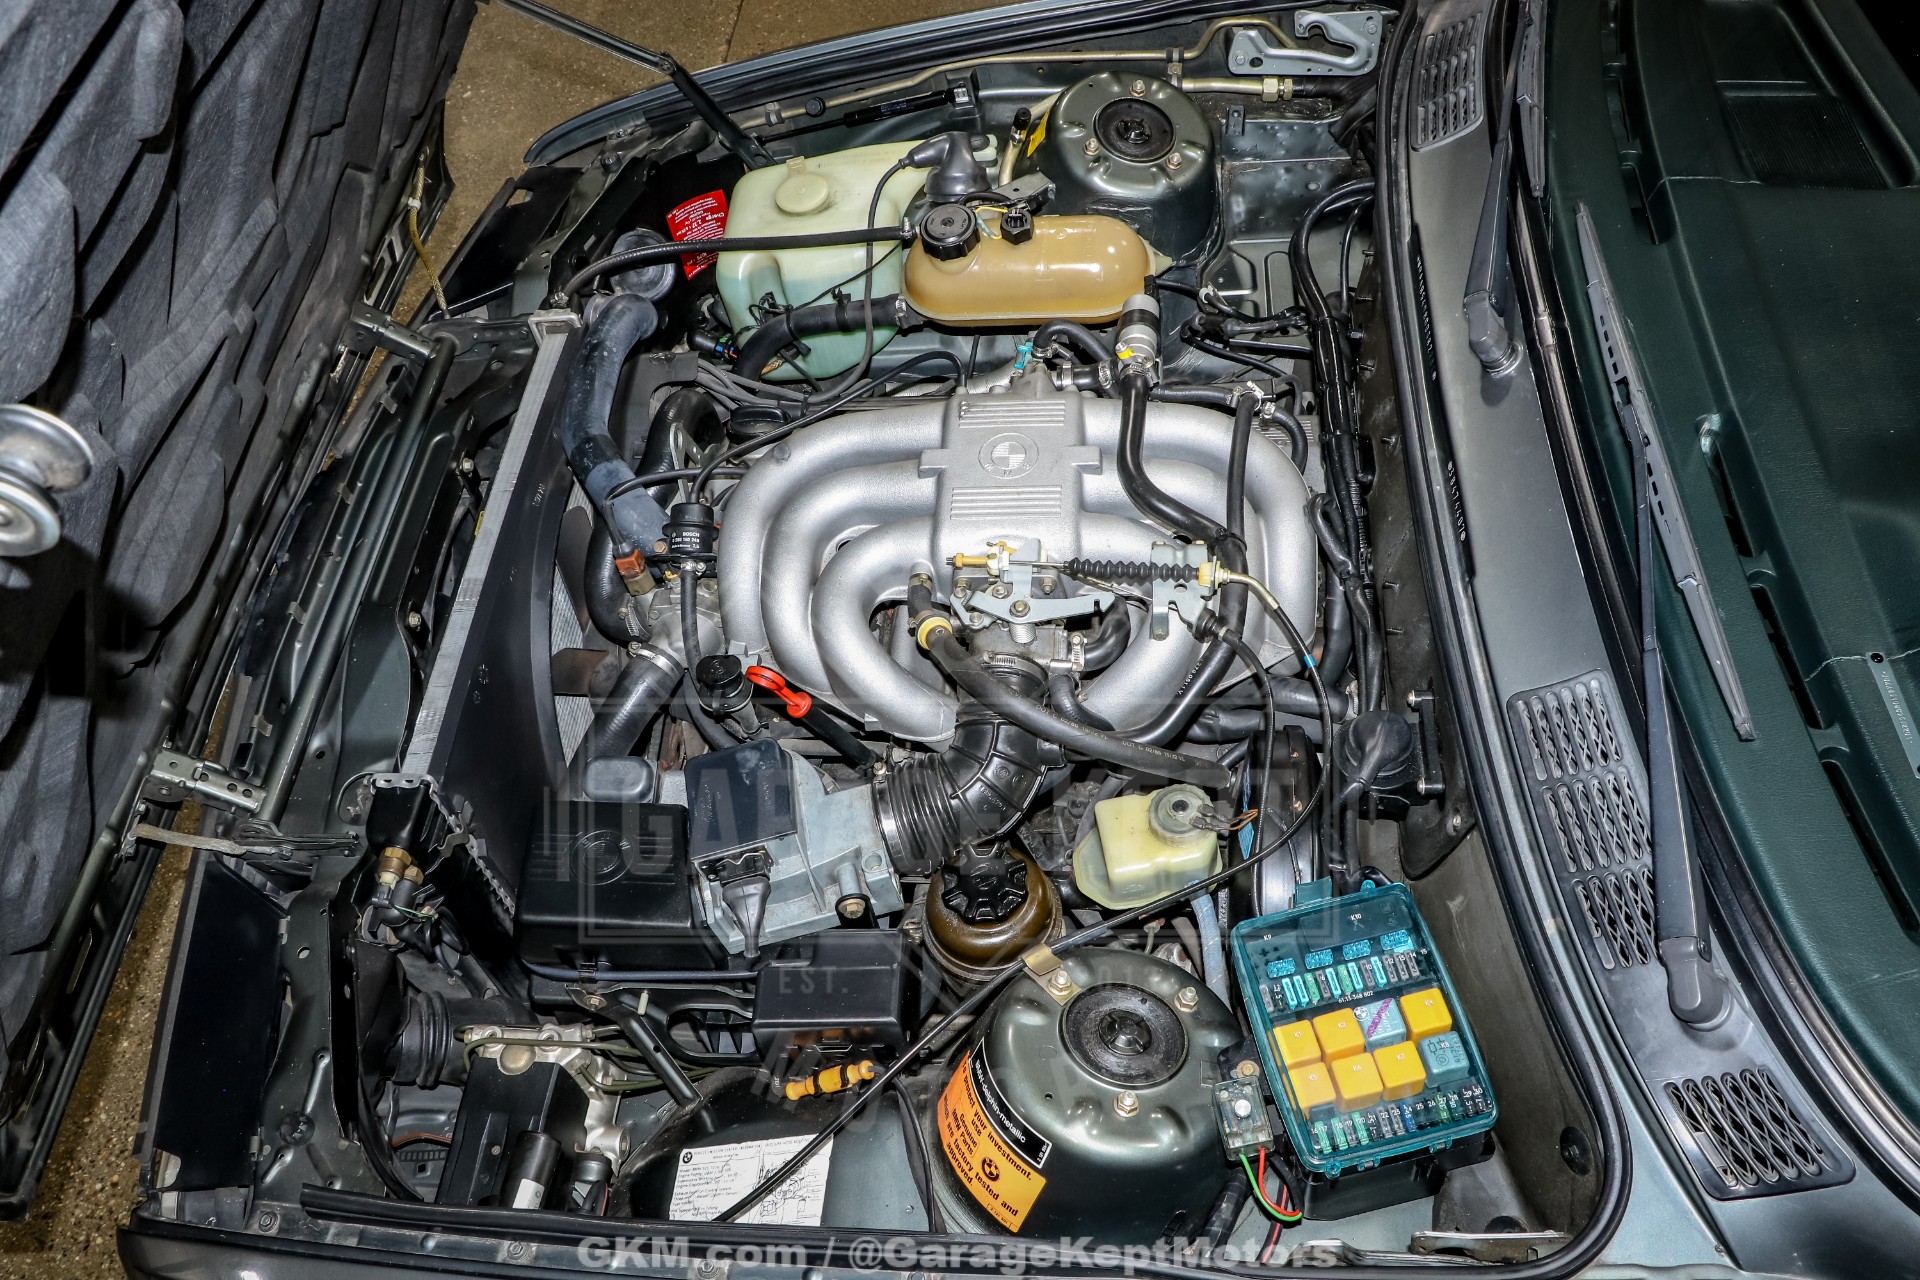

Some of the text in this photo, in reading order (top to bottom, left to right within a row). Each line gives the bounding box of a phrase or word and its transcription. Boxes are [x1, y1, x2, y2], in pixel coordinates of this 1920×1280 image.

[1350, 913, 1362, 922] K10
[1352, 1064, 1362, 1072] K6
[960, 1113, 978, 1148] Genuine
[964, 1076, 976, 1108] protect
[974, 1110, 988, 1131] your
[988, 1132, 1032, 1181] investment.
[972, 1118, 982, 1137] use
[960, 1131, 974, 1156] Parts
[946, 1142, 974, 1187] approved.
[946, 1122, 954, 1138] are
[954, 1138, 974, 1173] factory
[974, 1172, 1000, 1201] tested
[1000, 1200, 1019, 1217] and
